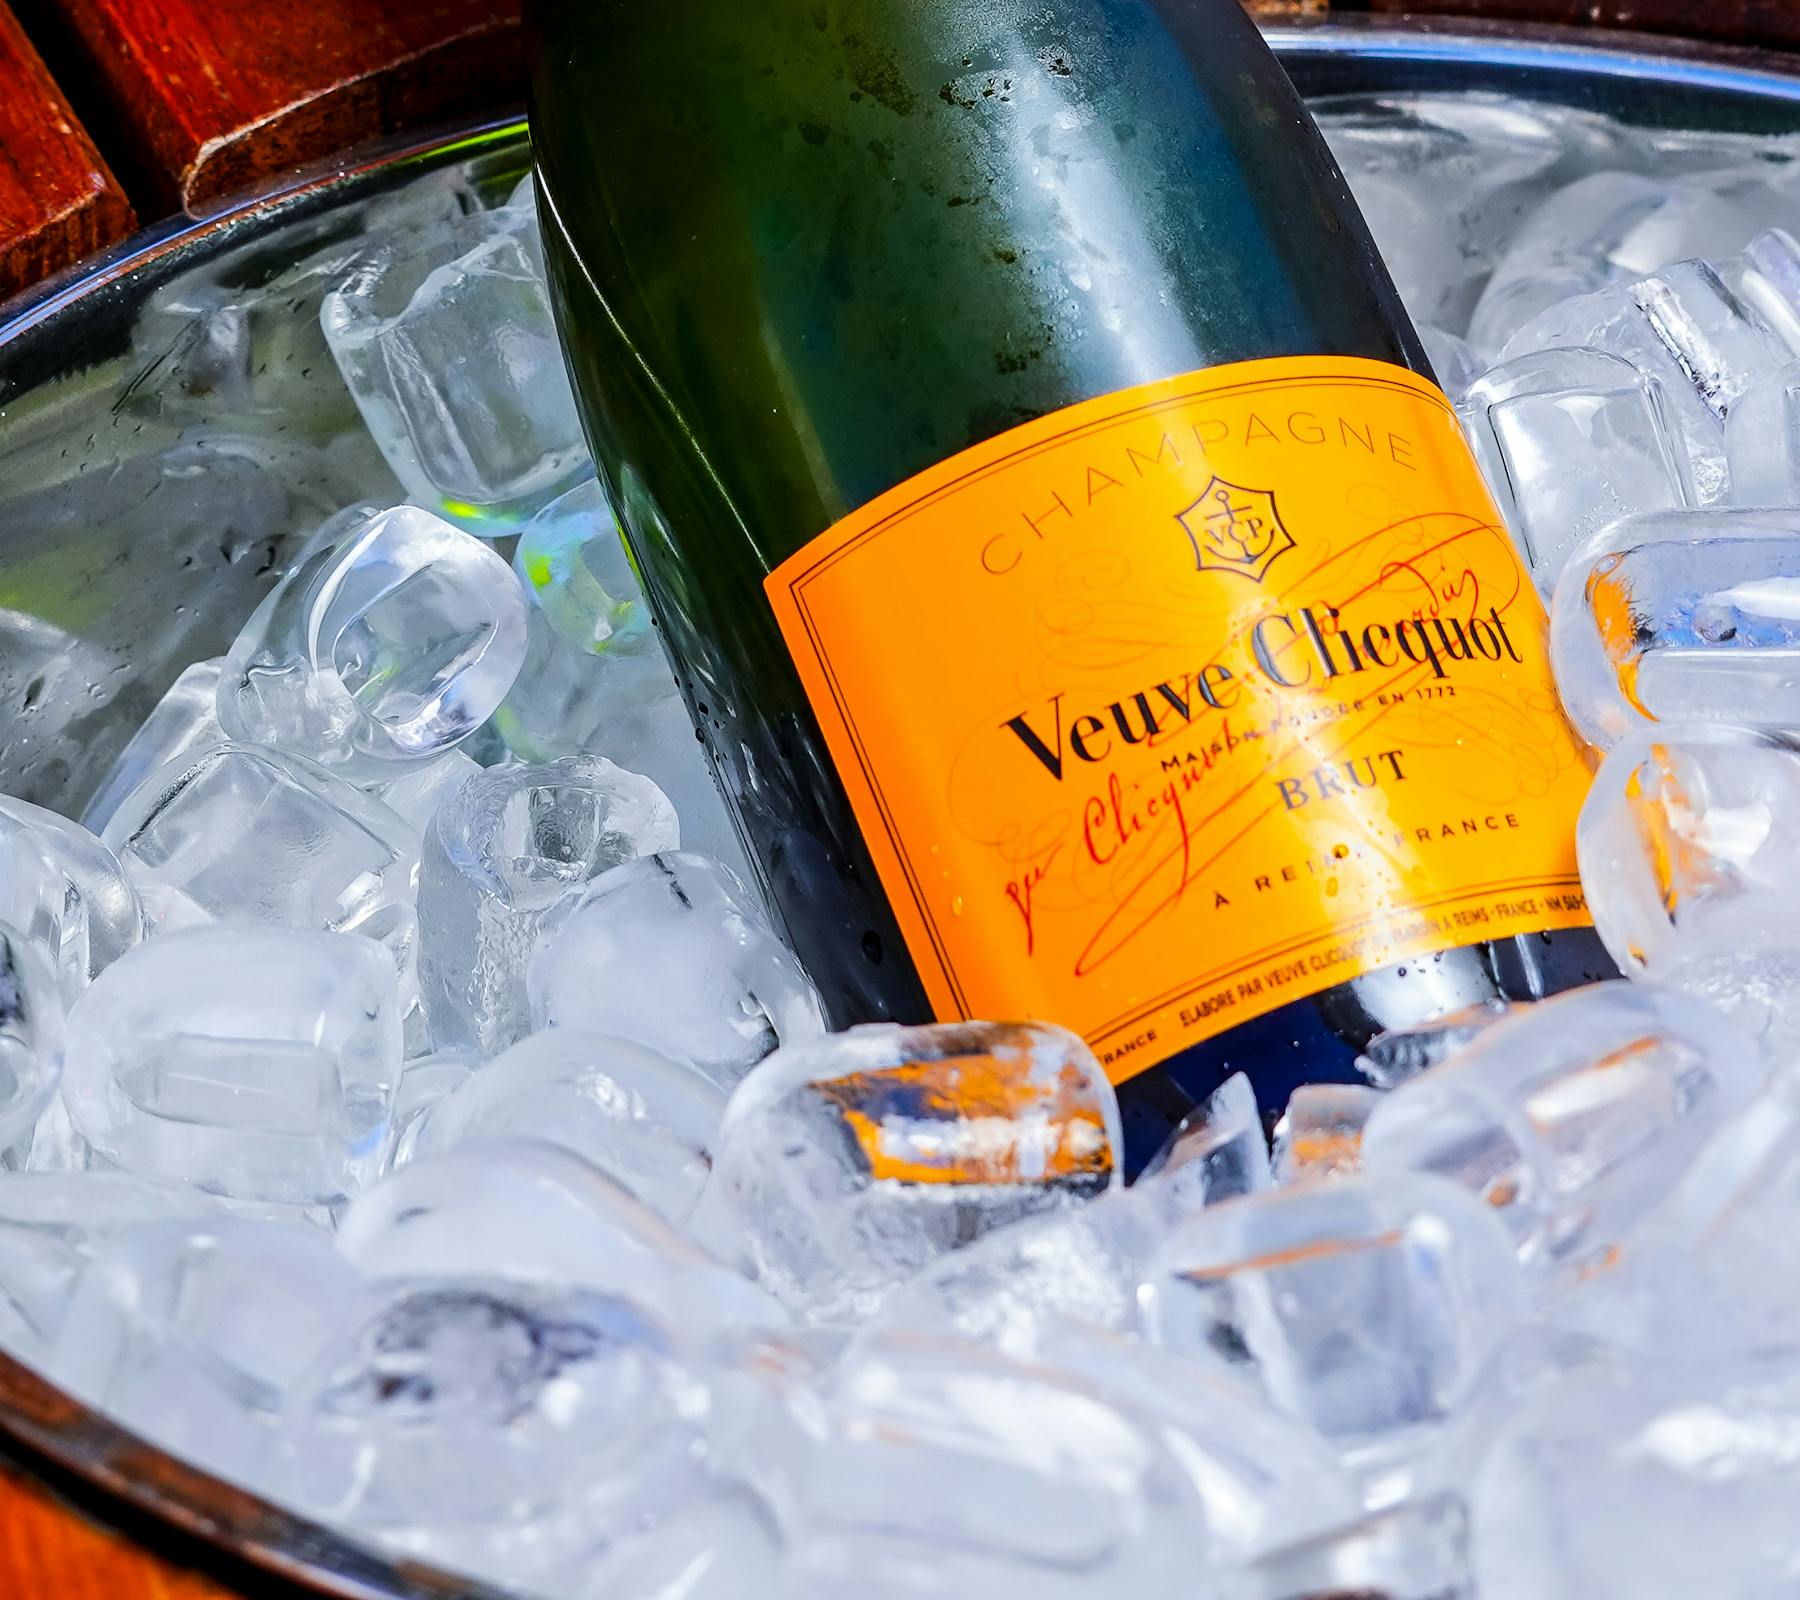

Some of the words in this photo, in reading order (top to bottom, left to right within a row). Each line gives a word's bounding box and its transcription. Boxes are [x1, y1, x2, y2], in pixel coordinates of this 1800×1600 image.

[981, 411, 1417, 574] CHAMPAGNE
[998, 662, 1242, 782] Veuve
[1251, 606, 1523, 689] Clicquot
[1160, 727, 1258, 773] MAISON
[1377, 692, 1405, 706] EN
[1416, 685, 1457, 700] 1772
[1275, 749, 1407, 811] BRUT
[1254, 841, 1364, 892] REIM
[1394, 813, 1520, 847] FRANCE
[1237, 978, 1264, 1002] PAR
[1263, 959, 1309, 990] VEUVE
[1309, 937, 1367, 972] CLICQ
[1098, 1028, 1159, 1065] RANCE
